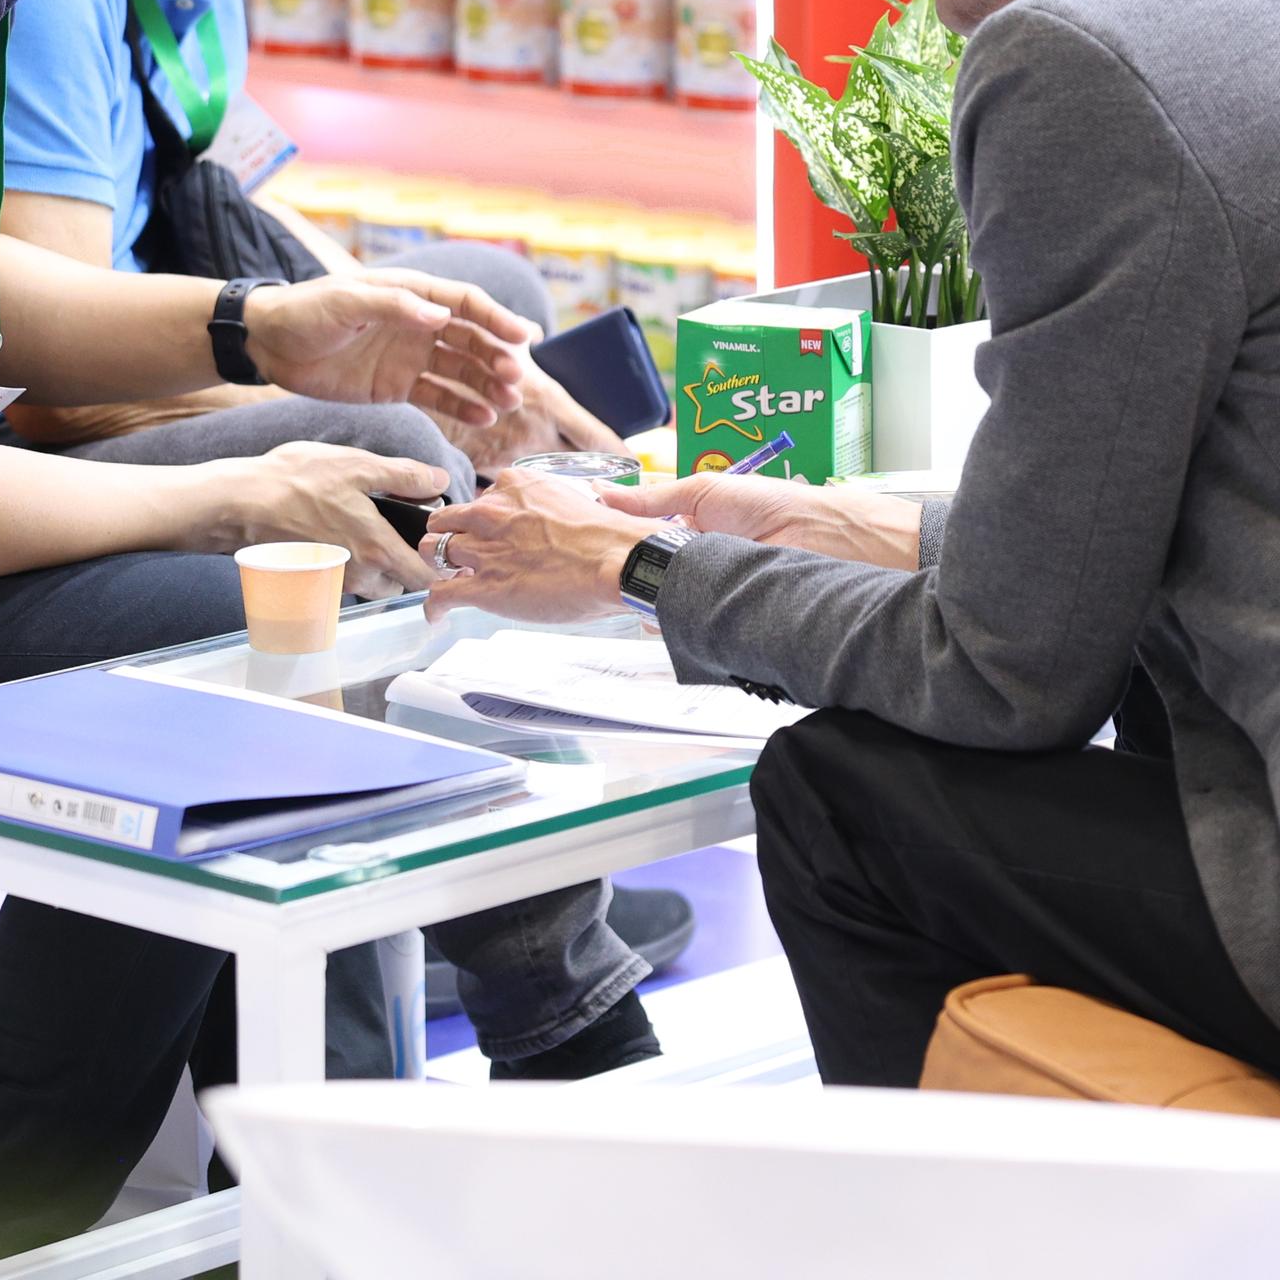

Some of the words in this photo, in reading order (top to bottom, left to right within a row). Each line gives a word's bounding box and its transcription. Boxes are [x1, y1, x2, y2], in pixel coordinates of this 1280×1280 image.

[712, 340, 756, 353] VINAMILK
[800, 339, 822, 351] NEW
[706, 373, 760, 396] Southern
[731, 385, 824, 420] Star
